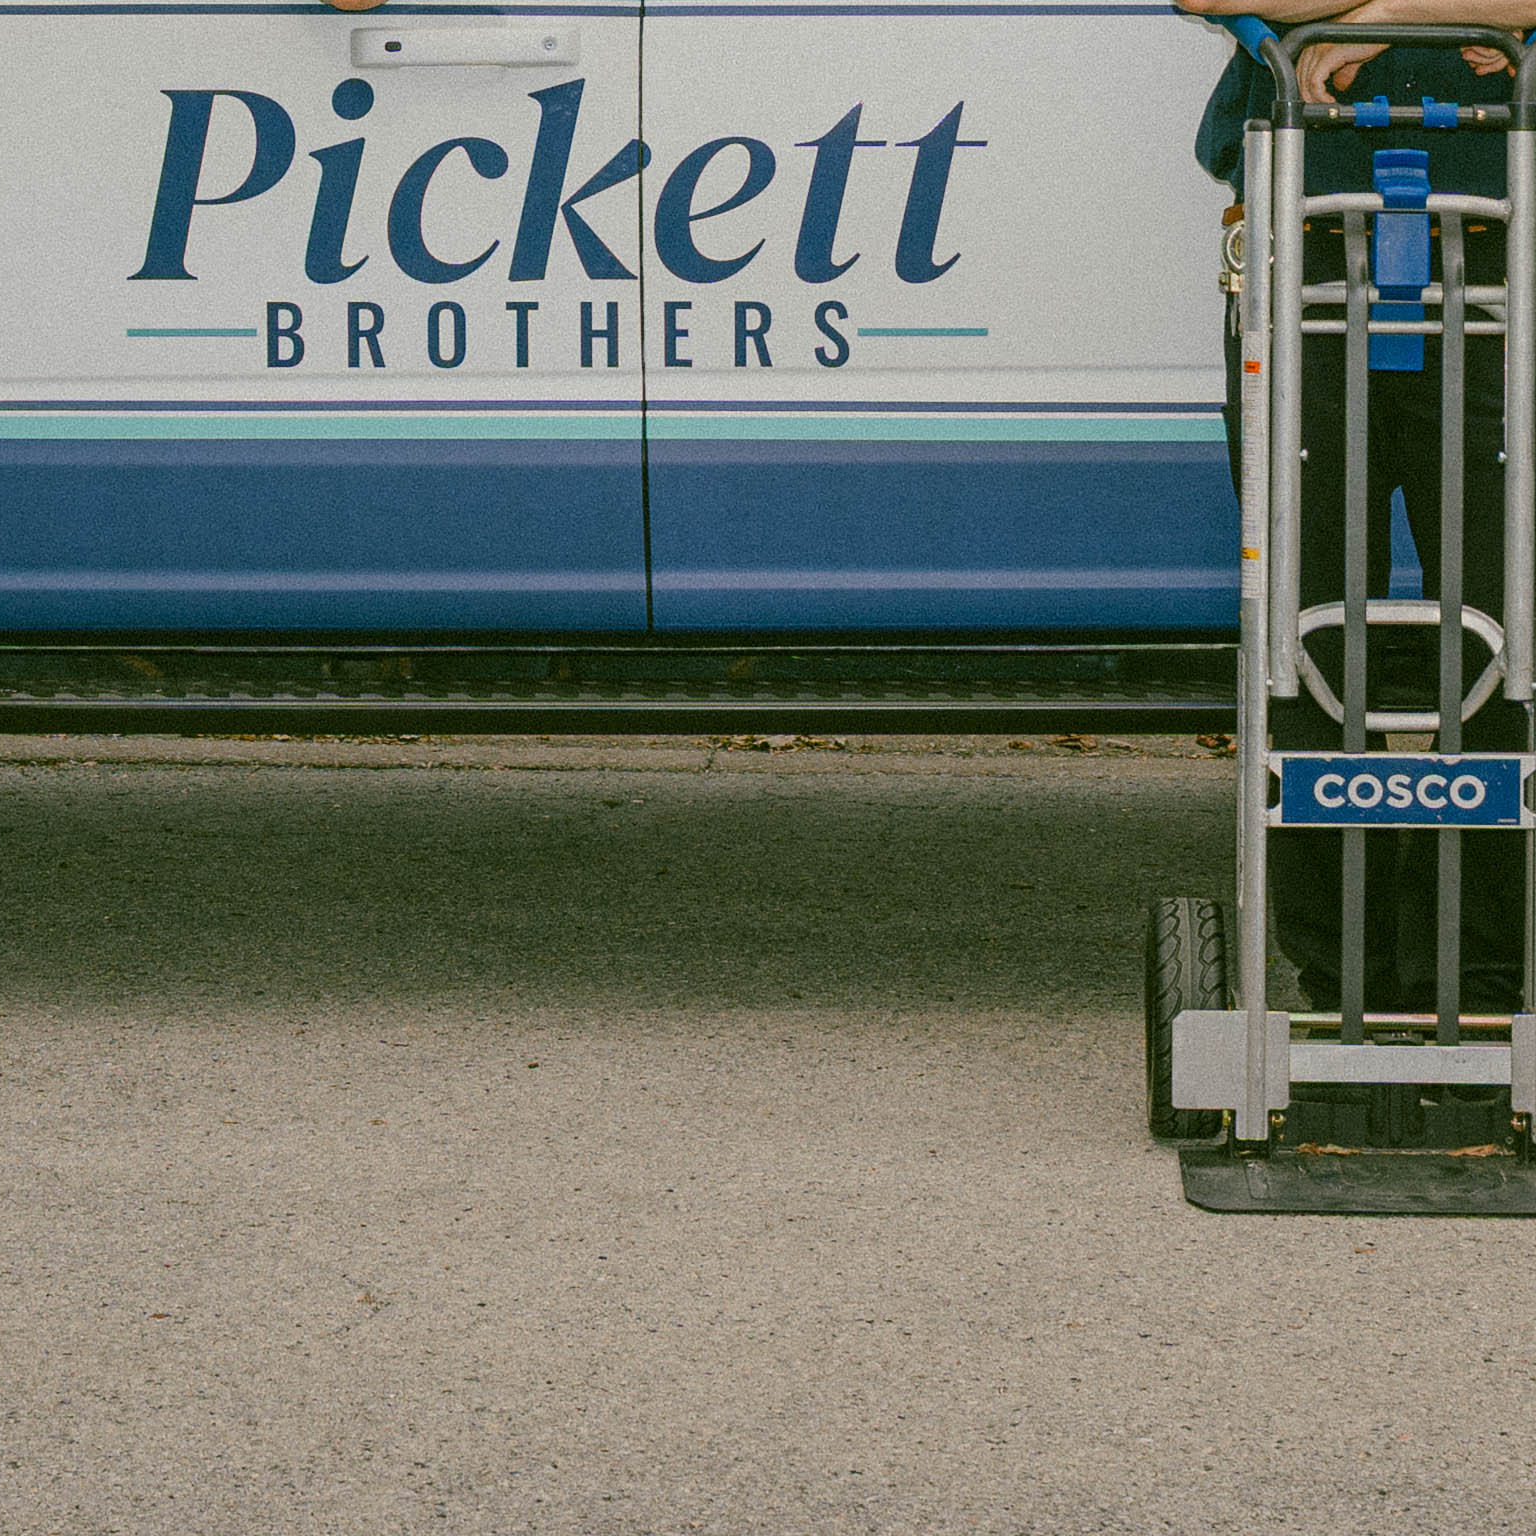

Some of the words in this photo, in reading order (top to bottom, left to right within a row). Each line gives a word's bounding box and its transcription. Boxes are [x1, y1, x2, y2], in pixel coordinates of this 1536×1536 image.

[126, 77, 988, 285] Pickett
[266, 300, 852, 368] BROTHERS
[1314, 773, 1486, 810] COSCO
